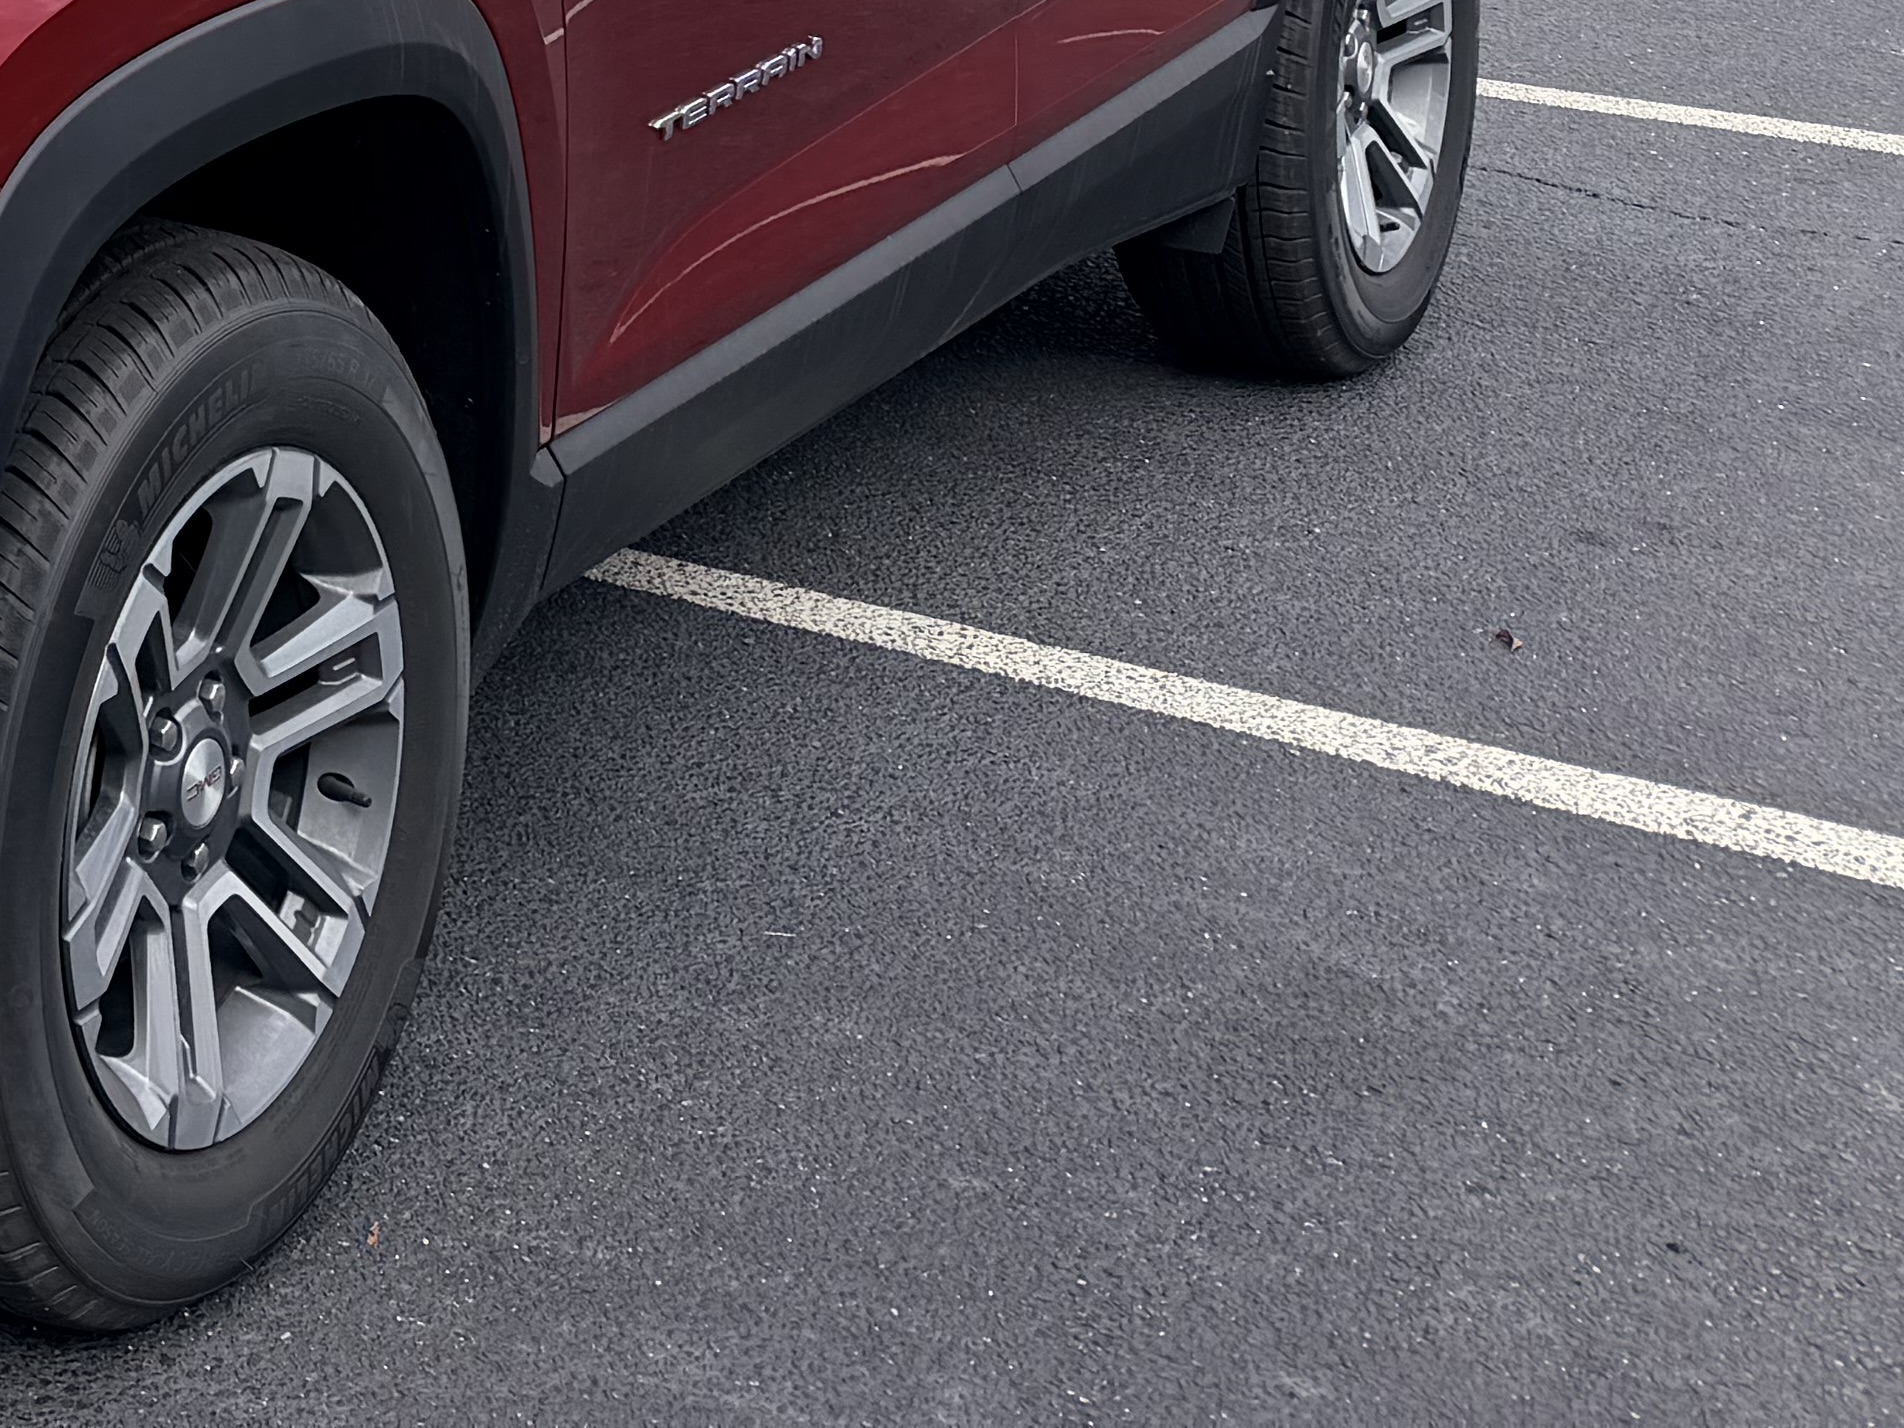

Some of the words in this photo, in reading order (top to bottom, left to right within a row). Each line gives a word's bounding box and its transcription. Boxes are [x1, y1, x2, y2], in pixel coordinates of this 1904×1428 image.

[647, 33, 824, 142] TERRAIN
[137, 360, 270, 519] MICHELIN
[186, 765, 222, 802] GMC
